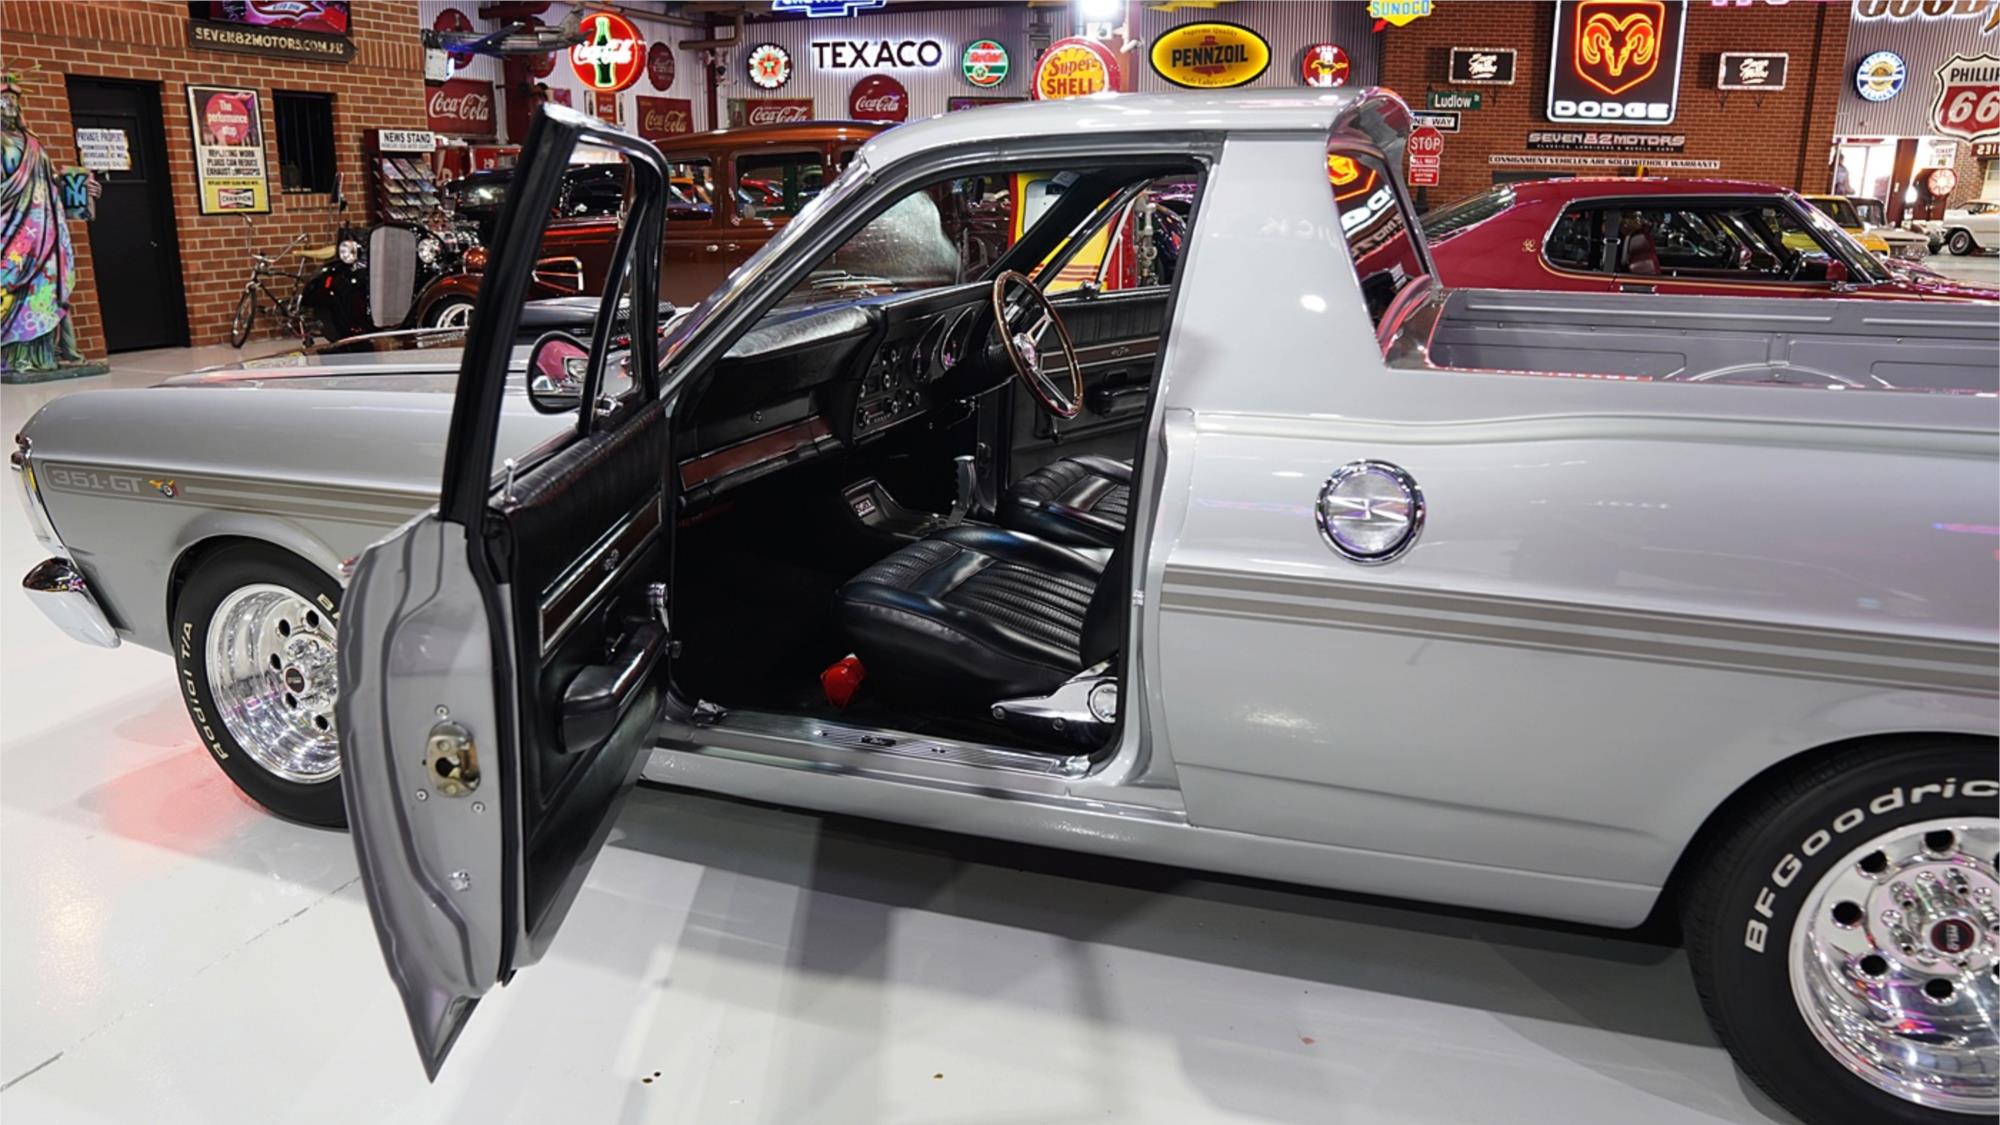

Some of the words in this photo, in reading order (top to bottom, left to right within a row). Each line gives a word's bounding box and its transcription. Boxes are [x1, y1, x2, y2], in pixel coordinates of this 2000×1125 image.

[1372, 0, 1429, 15] SUNOCO
[812, 40, 942, 69] TEXACO
[1172, 44, 1249, 68] PENNZOIL
[1047, 78, 1096, 95] SHELL
[429, 90, 489, 121] Coca-Cola
[856, 95, 900, 113] Coca-Cola
[1434, 93, 1472, 108] Ludlow
[1948, 91, 2000, 123] 66
[1554, 100, 1669, 119] DODGE
[645, 109, 687, 133] Coca-Cola
[1432, 118, 1452, 126] WAY
[383, 132, 405, 142] NEWS
[407, 133, 431, 143] STAND
[1411, 137, 1441, 151] STOP
[1613, 135, 1685, 146] MOTORS
[1489, 156, 1548, 164] CONSIGNMENT
[1550, 157, 1589, 165] VEHICLES
[1608, 158, 1630, 166] SOLD
[1631, 159, 1669, 167] WITHOUT
[1671, 160, 1720, 168] WARRANTY
[222, 195, 251, 203] CHAMPION
